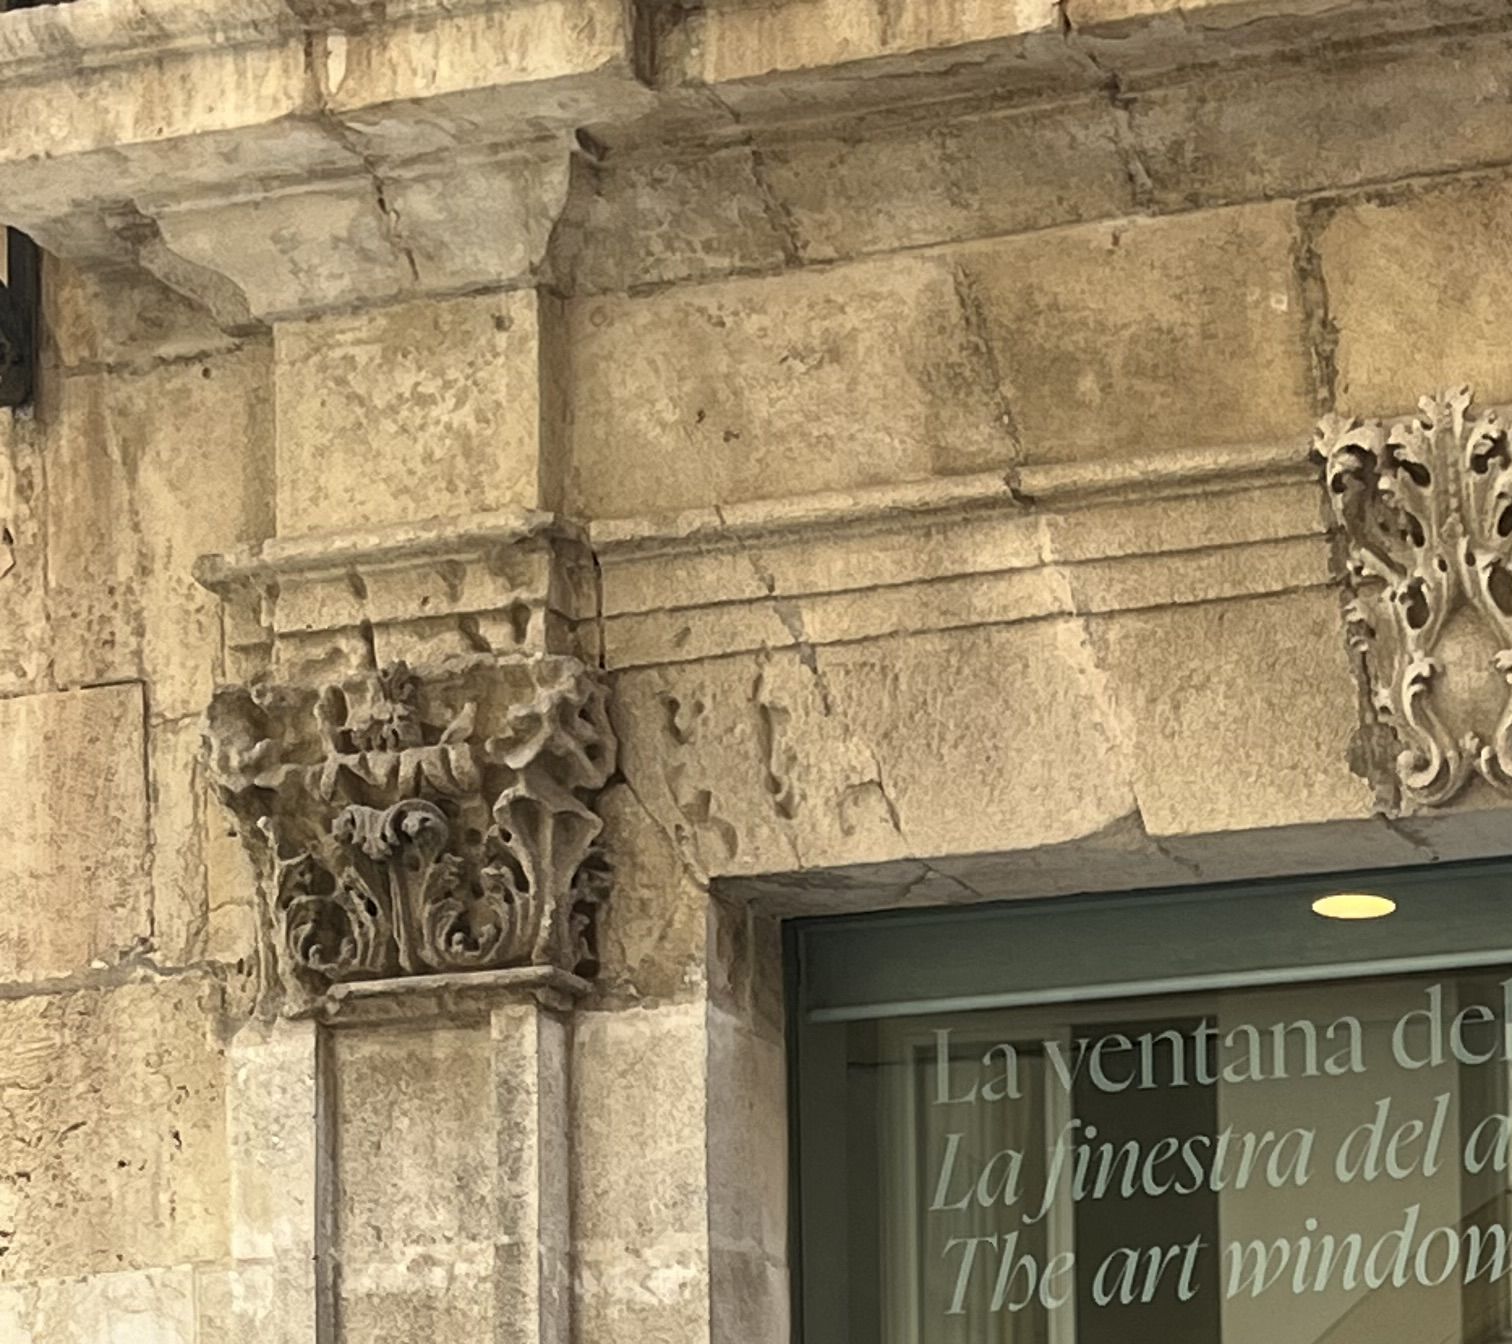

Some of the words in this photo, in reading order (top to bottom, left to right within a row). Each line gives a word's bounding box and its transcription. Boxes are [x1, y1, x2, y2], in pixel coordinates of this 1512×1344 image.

[933, 1028, 1023, 1105] La
[1043, 1014, 1367, 1092] ventana
[928, 1132, 1024, 1211] La
[1022, 1118, 1316, 1225] finestra
[1335, 1093, 1451, 1185] del
[942, 1230, 1075, 1315] The
[1092, 1233, 1208, 1307] art
